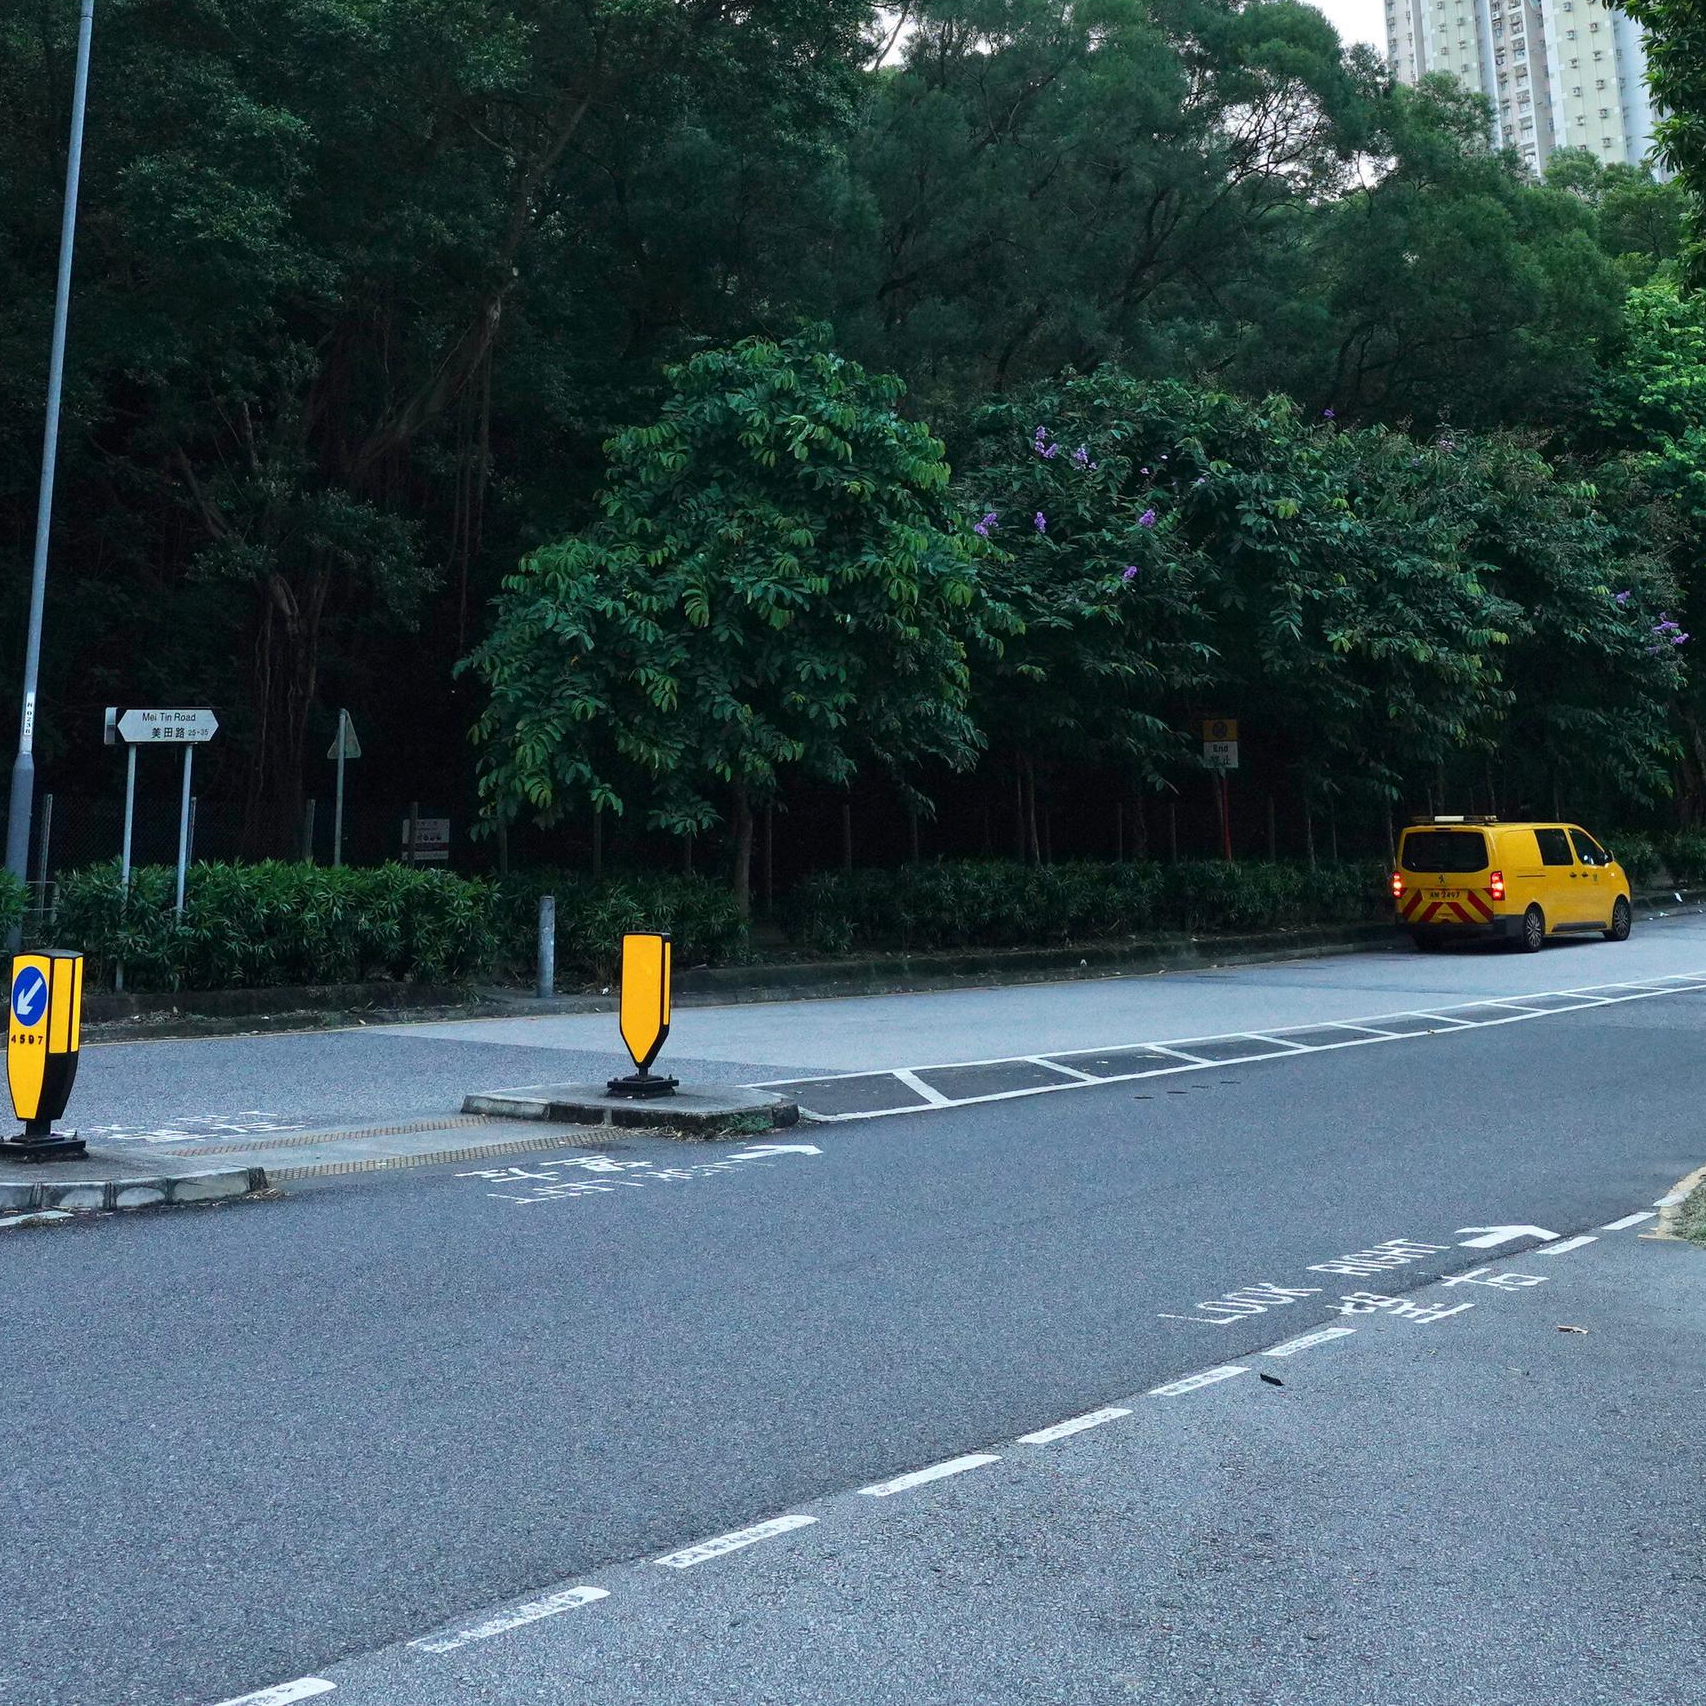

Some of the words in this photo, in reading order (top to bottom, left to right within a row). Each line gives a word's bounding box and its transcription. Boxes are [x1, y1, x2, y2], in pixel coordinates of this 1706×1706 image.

[142, 712, 157, 722] Mei
[159, 712, 172, 722] Tin
[173, 712, 197, 722] Road
[151, 727, 185, 739] 美田路
[1212, 744, 1229, 753] End
[1156, 1282, 1323, 1325] LOOK
[1305, 1238, 1451, 1277] RIGHT
